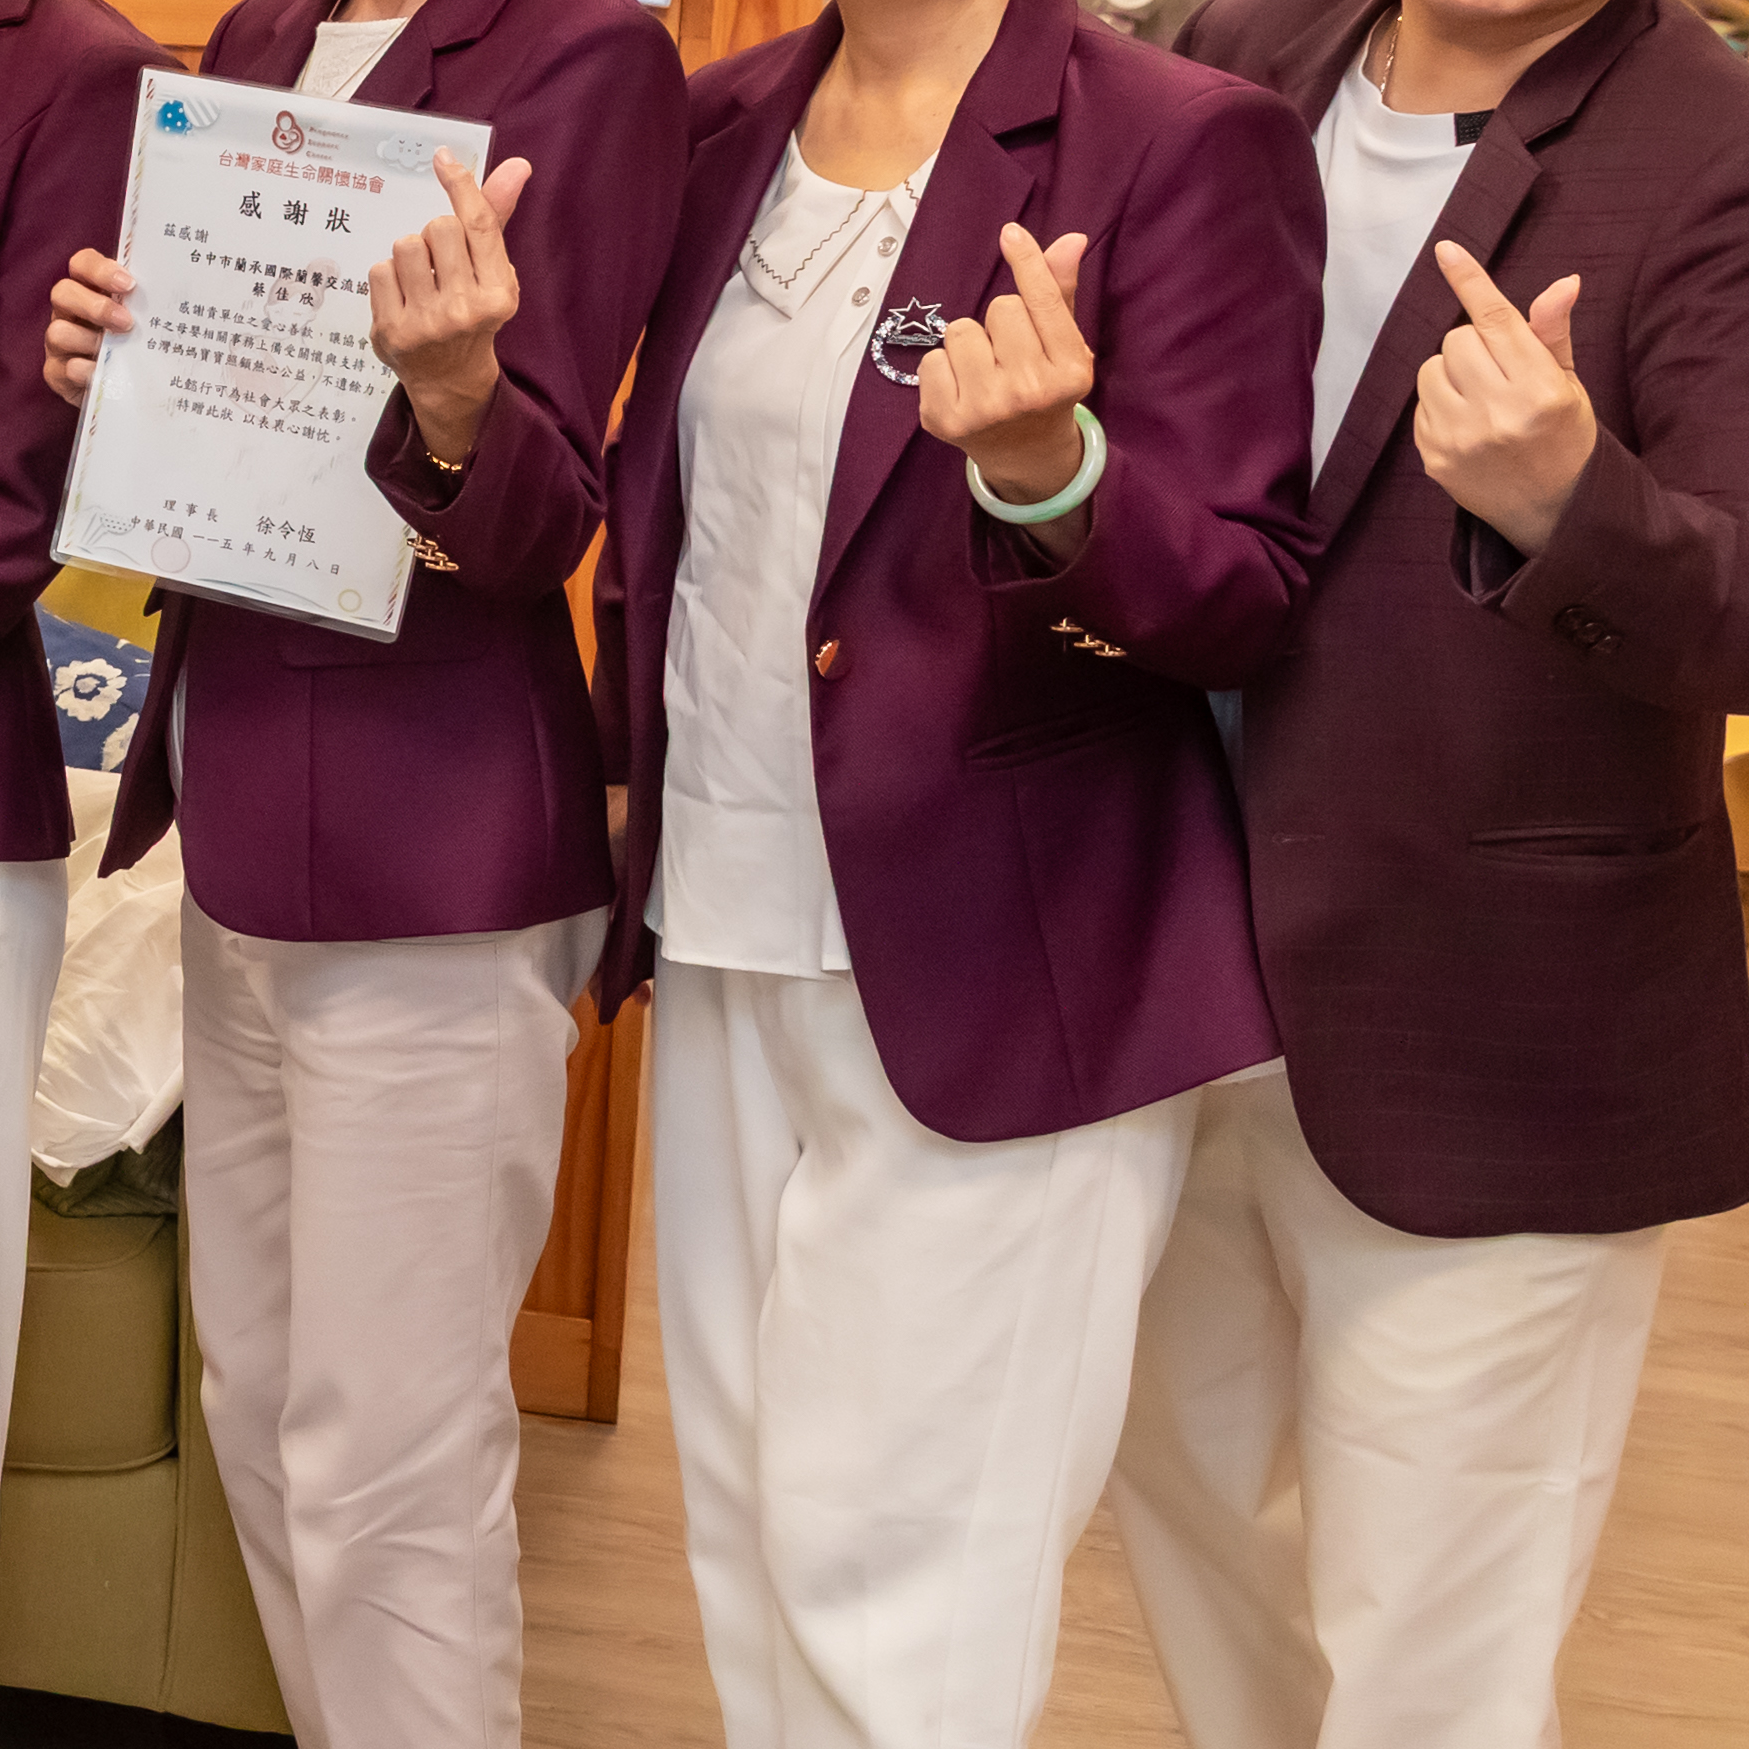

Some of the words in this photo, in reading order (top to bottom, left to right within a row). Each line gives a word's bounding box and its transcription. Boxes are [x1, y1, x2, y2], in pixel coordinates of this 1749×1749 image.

[218, 149, 386, 195] 台灣家庭生命關懷協會
[239, 190, 353, 234] 感謝狀
[252, 281, 316, 308] 蔡佳欣
[178, 300, 376, 352] 感謝貴單位之愛心善款，讓協會
[162, 499, 218, 523] 理事長
